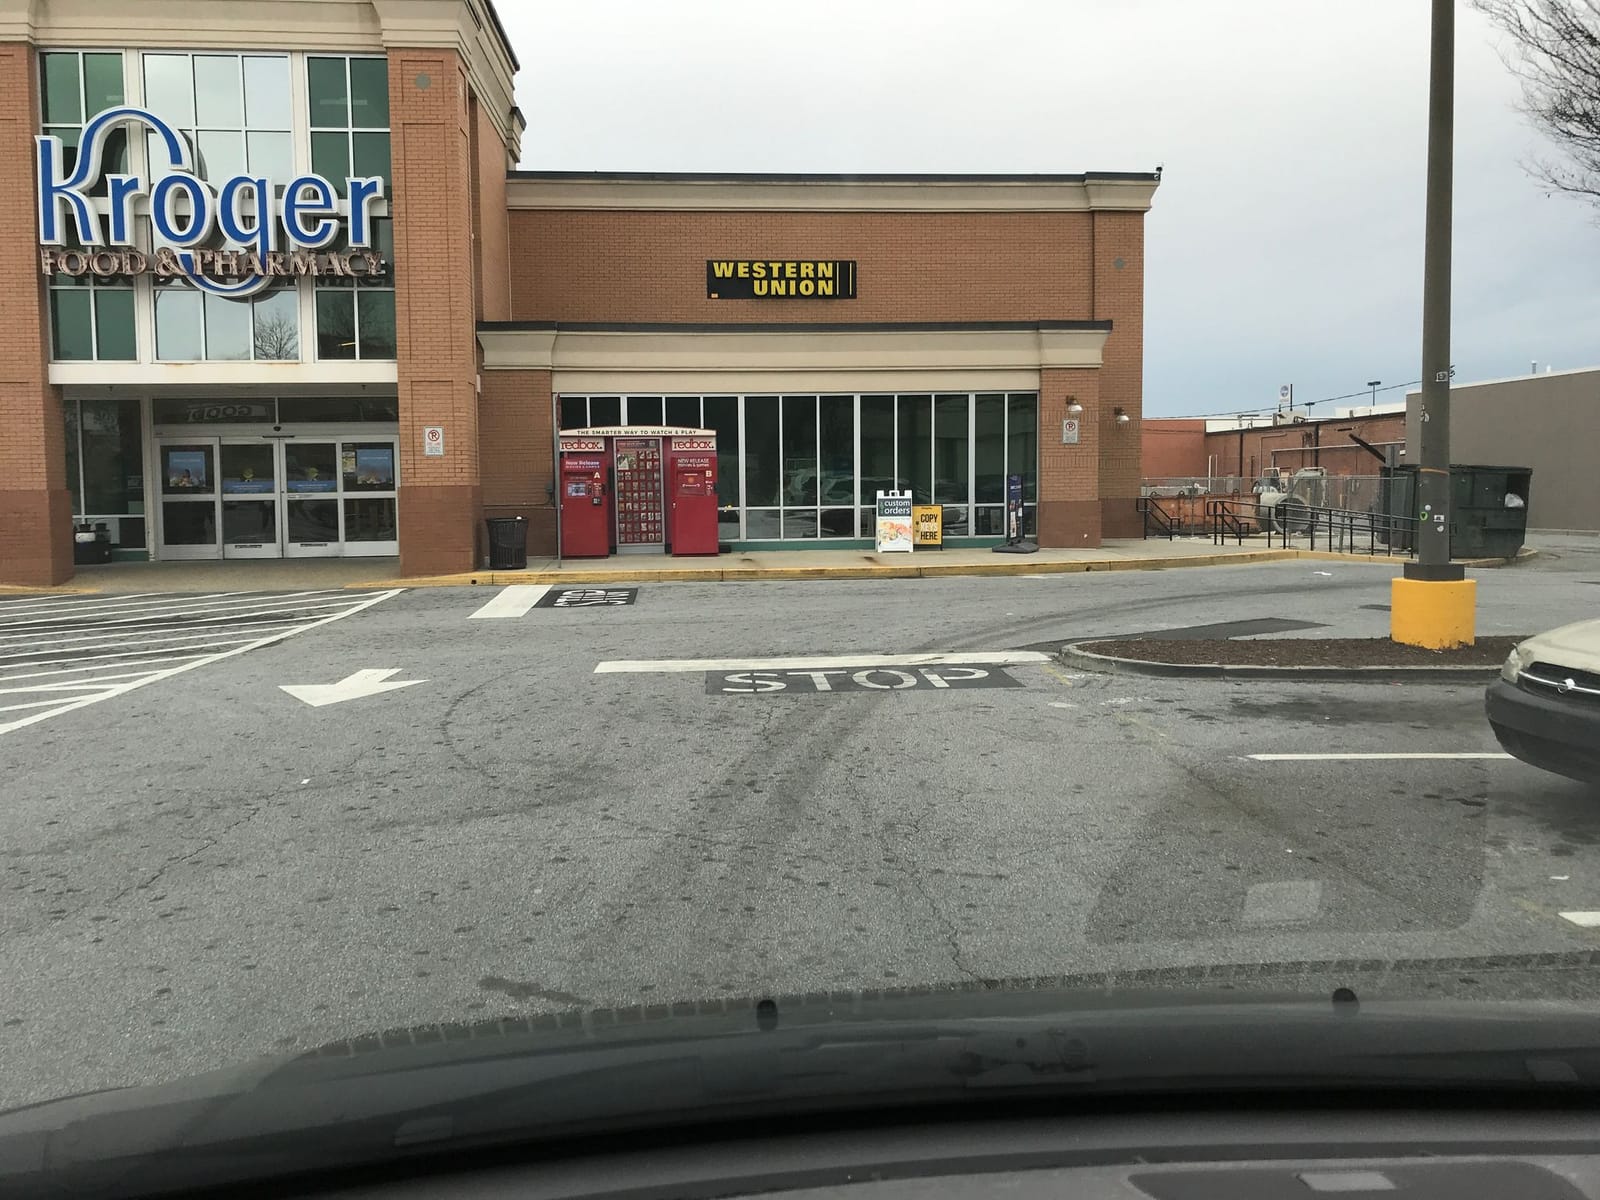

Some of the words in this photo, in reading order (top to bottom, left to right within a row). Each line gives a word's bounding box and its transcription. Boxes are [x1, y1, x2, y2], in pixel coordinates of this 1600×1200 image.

[35, 106, 384, 297] Kroger
[39, 249, 148, 277] FOOD
[154, 246, 188, 277] &
[192, 249, 384, 277] PHARMACY
[713, 262, 833, 278] WESTERN
[753, 279, 833, 296] UNION
[593, 471, 601, 479] A
[705, 470, 713, 478] B
[920, 514, 938, 522] COPY
[920, 531, 938, 540] HERE
[722, 667, 990, 692] STOP
